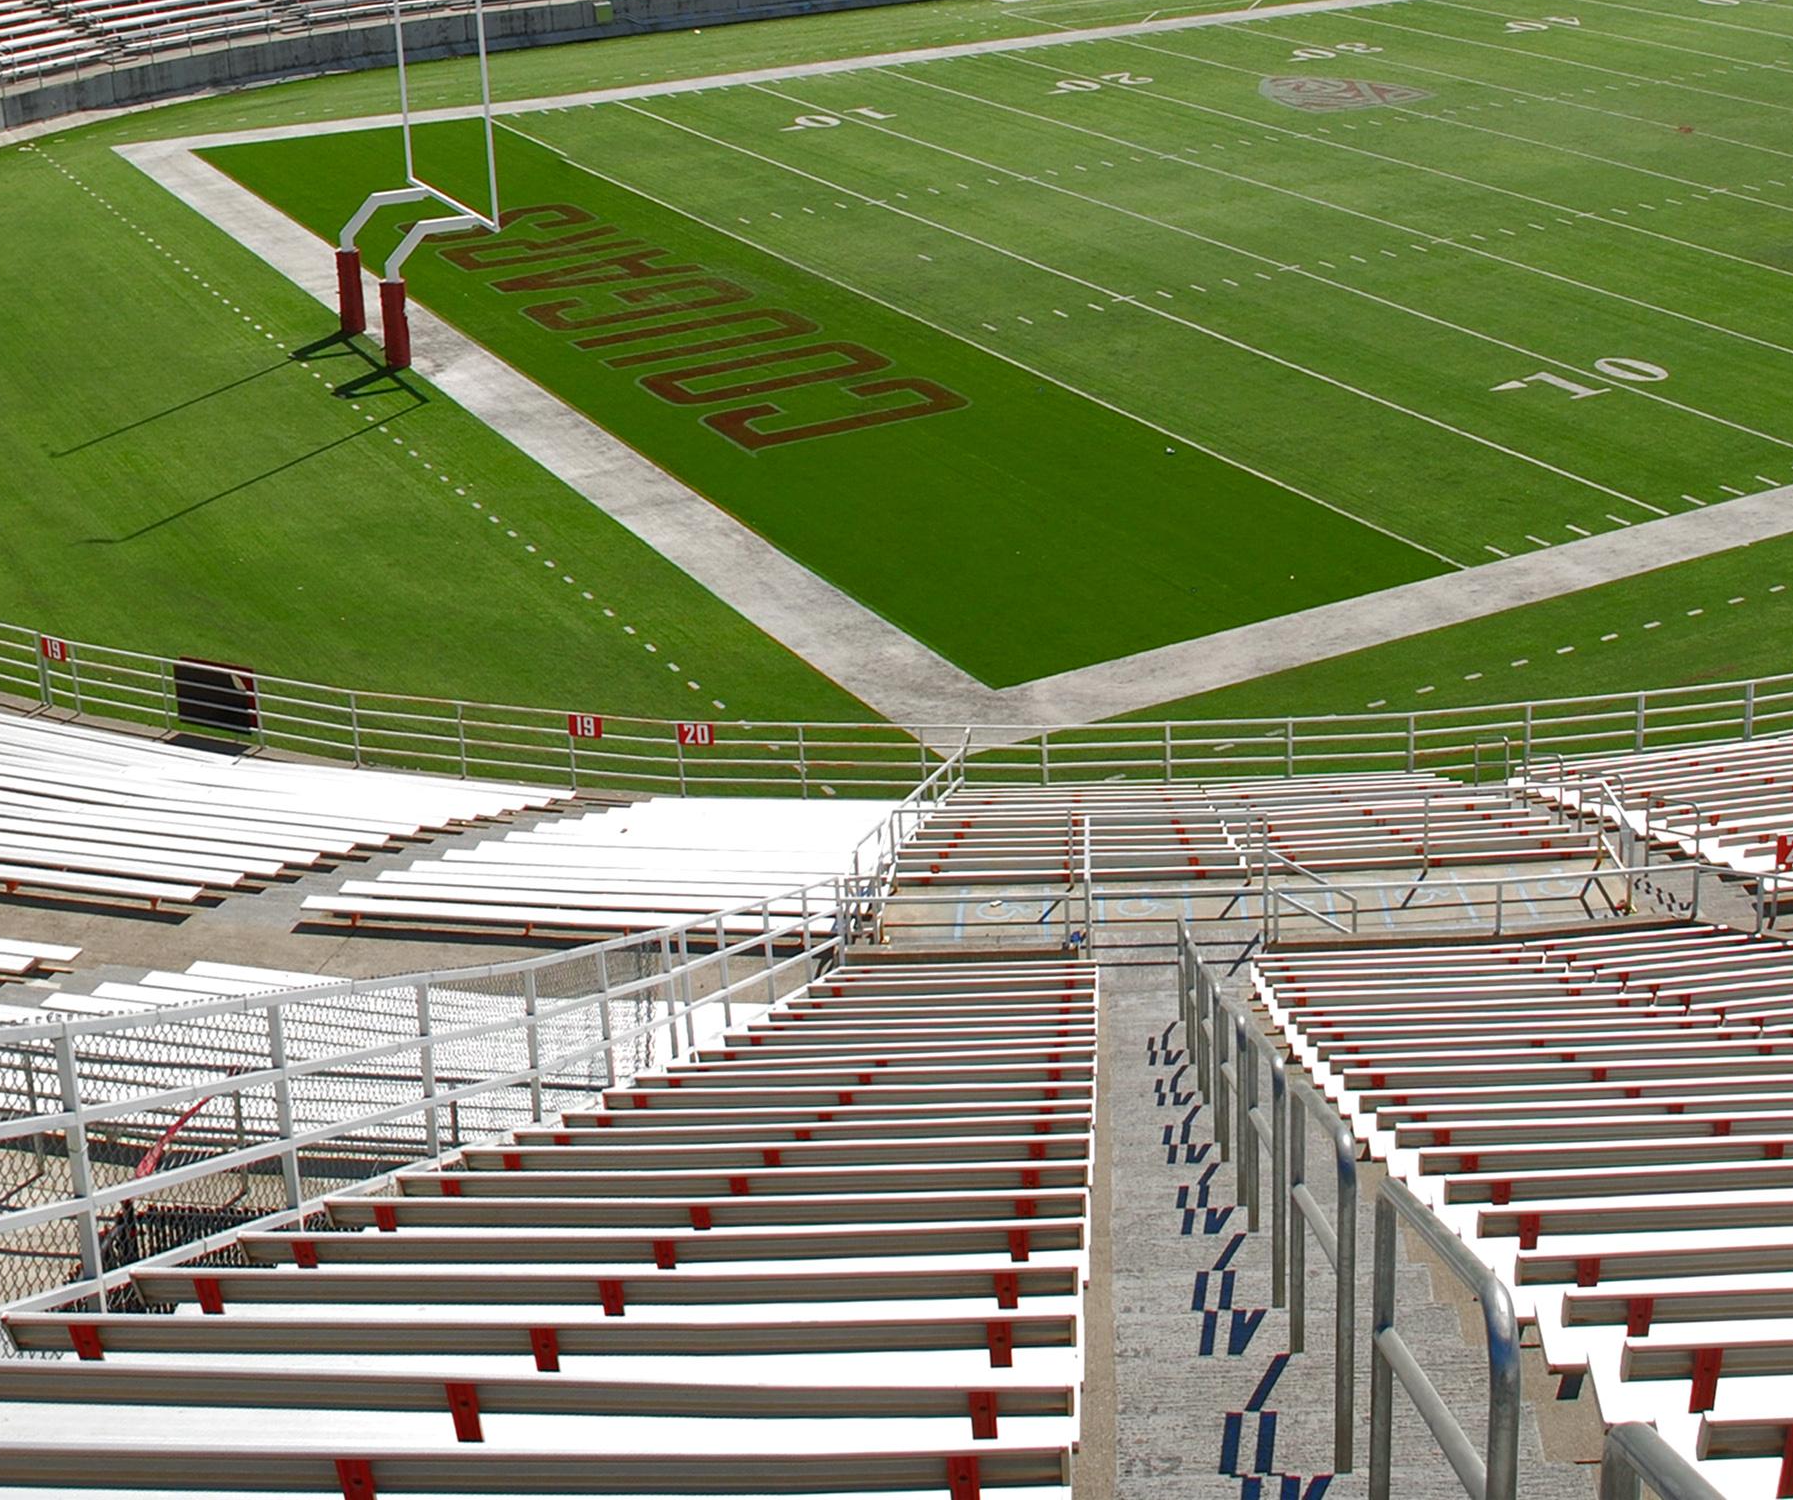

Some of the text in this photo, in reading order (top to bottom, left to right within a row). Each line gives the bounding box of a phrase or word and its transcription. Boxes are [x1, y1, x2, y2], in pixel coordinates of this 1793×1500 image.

[398, 203, 972, 457] COUGARS
[1522, 357, 1669, 400] 10
[47, 638, 62, 660] 19
[576, 715, 595, 737] 19
[683, 723, 709, 744] 20
